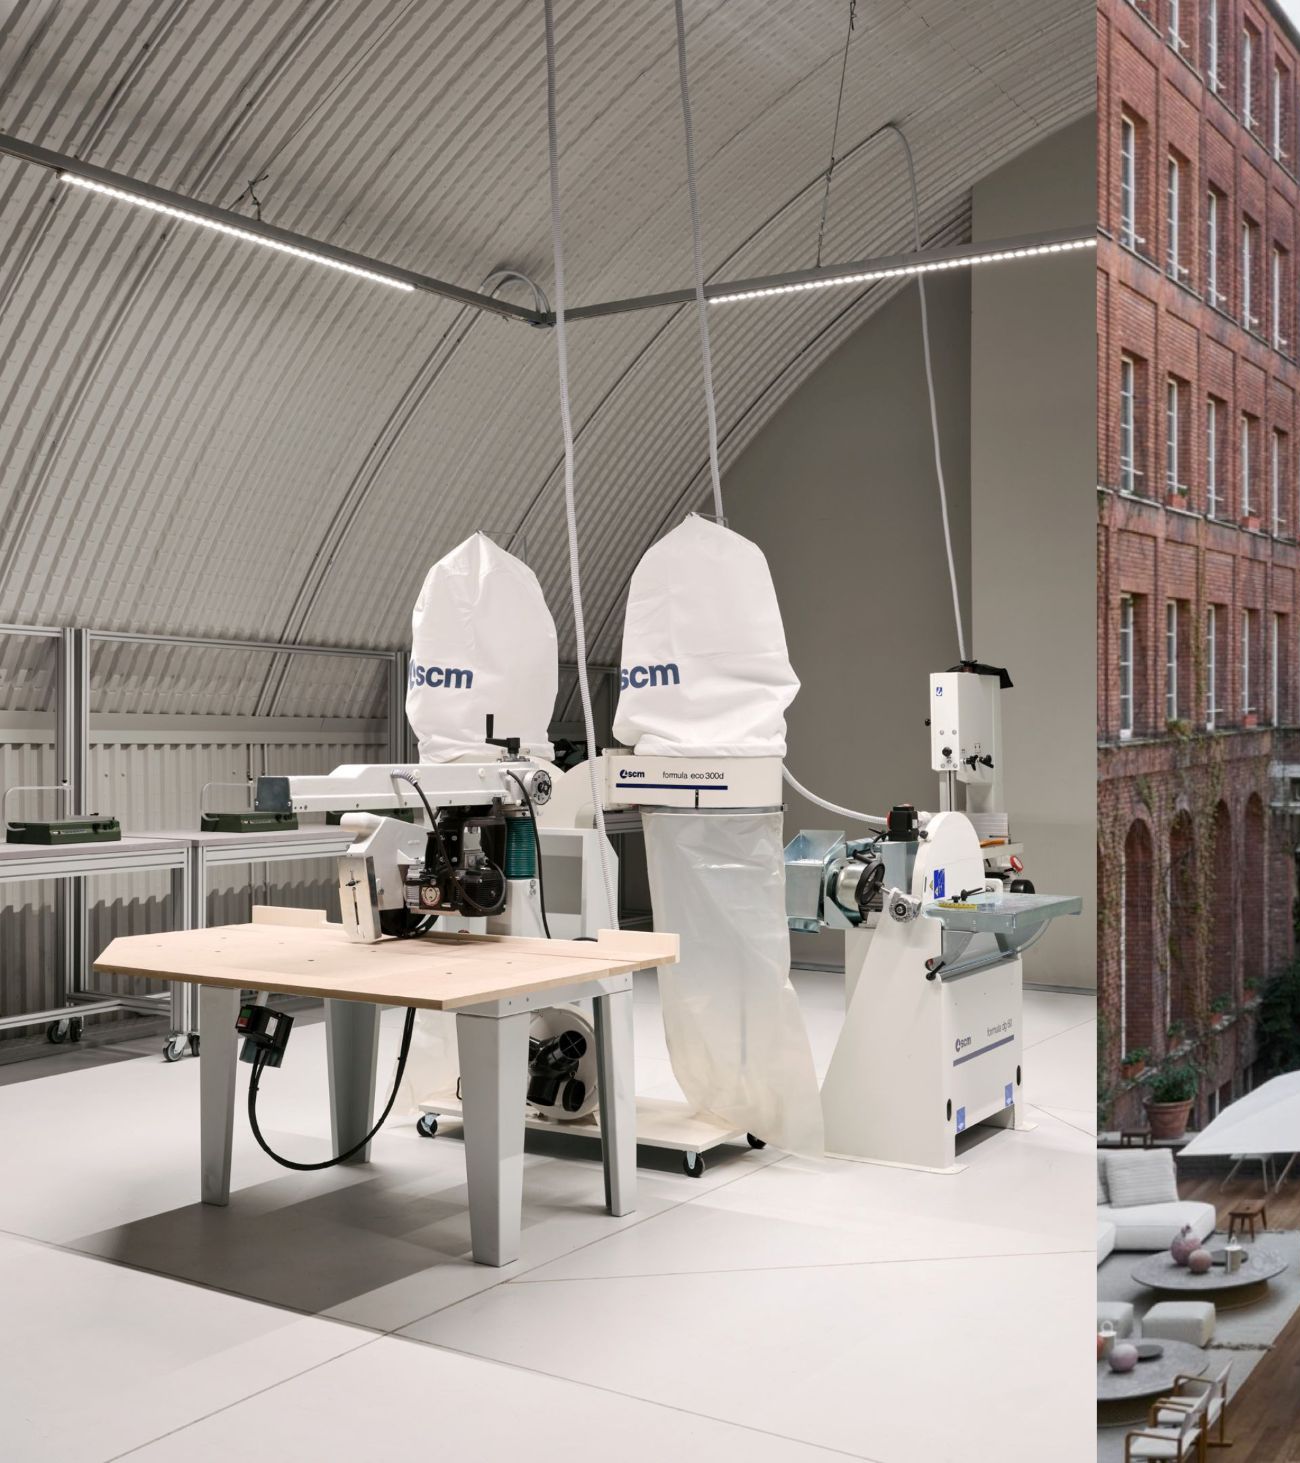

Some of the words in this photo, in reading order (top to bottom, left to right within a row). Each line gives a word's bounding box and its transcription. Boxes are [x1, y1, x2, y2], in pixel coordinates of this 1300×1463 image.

[416, 665, 473, 689] scm
[620, 663, 680, 691] scm
[662, 771, 688, 779] formula
